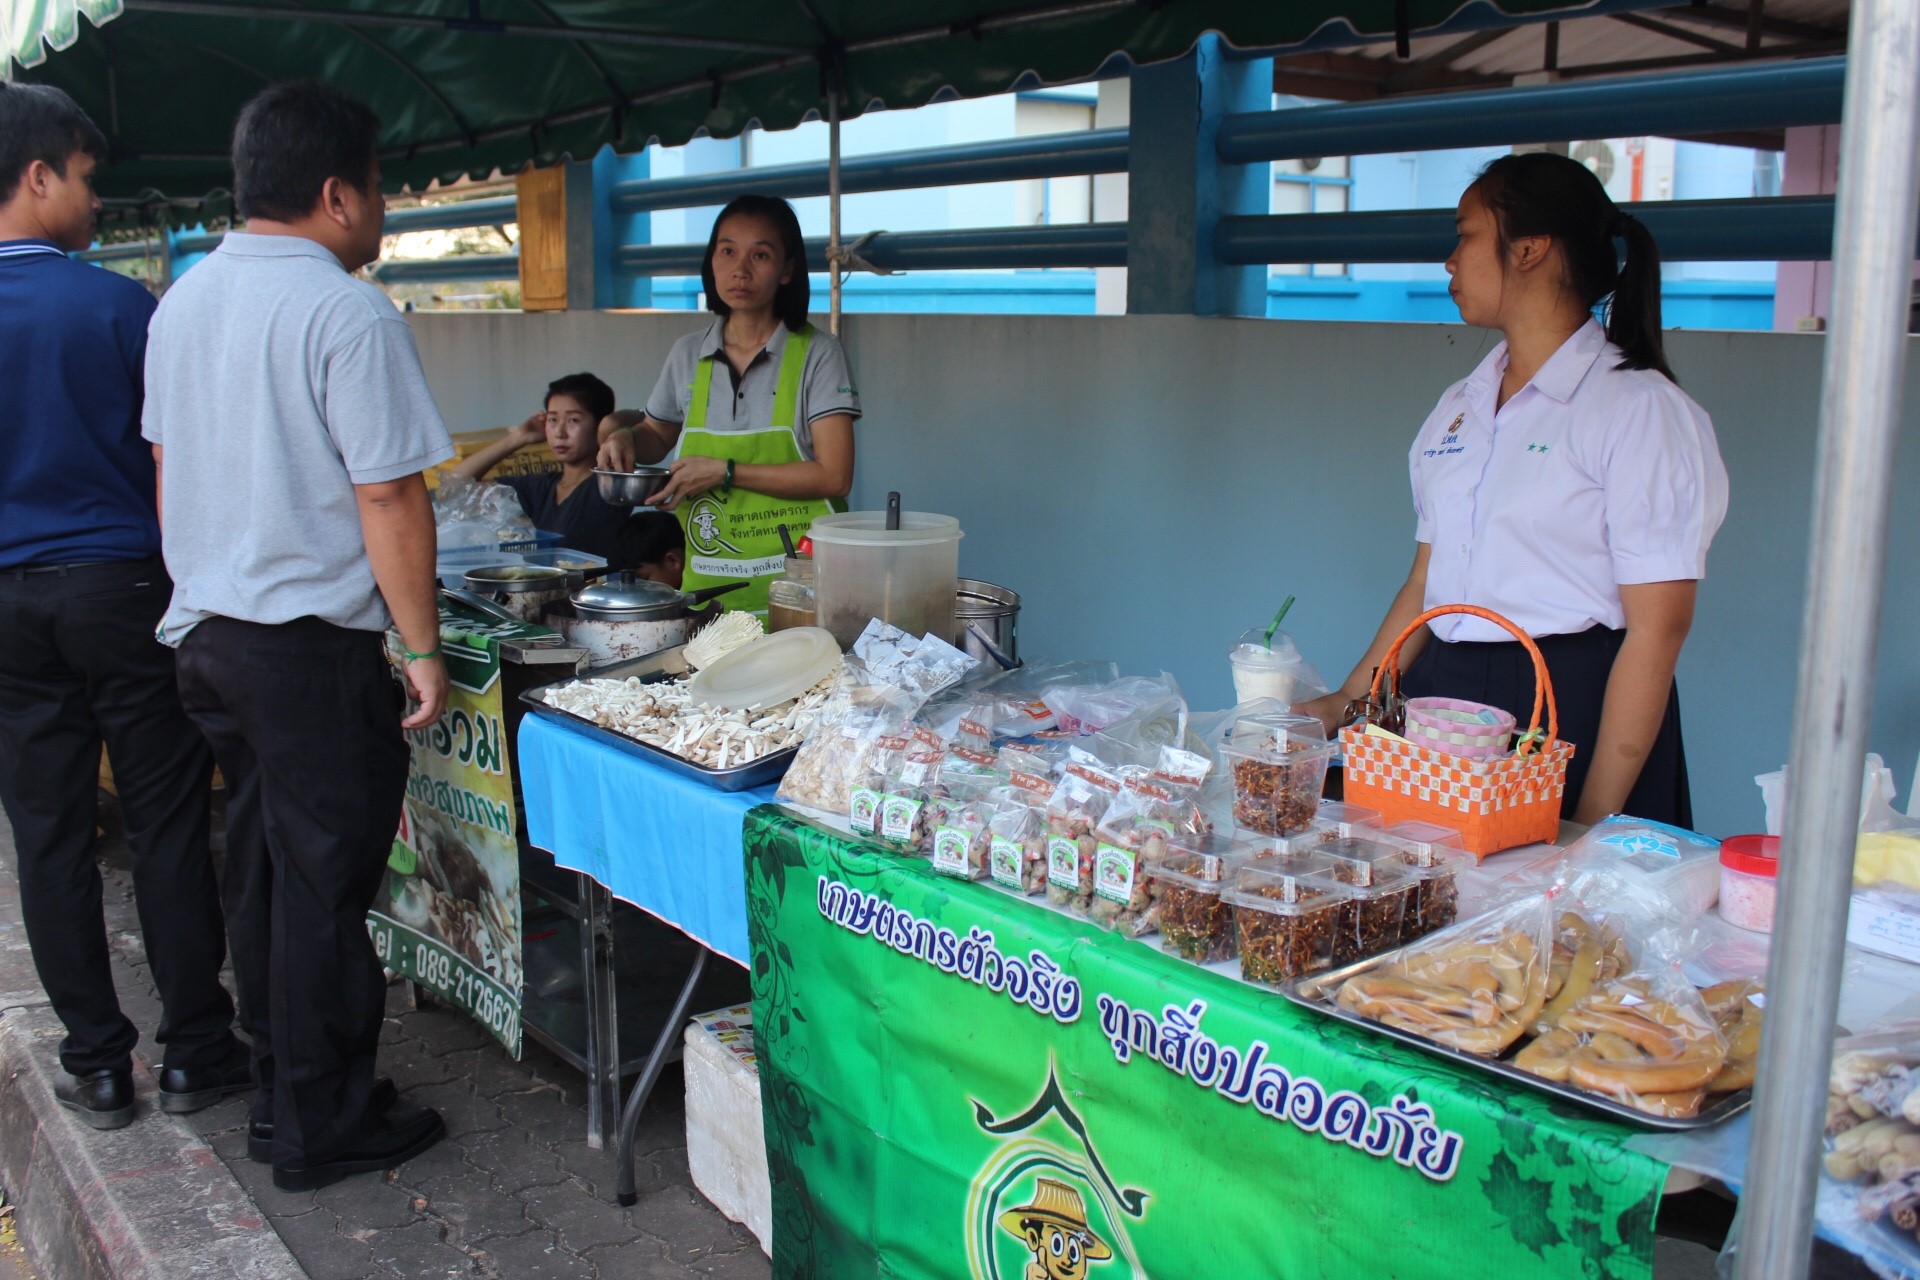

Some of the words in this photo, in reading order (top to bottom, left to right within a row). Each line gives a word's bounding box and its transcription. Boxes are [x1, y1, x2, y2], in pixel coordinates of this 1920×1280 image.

[729, 505, 810, 523] ตลาดเกษตรกร
[729, 522, 811, 539] จังหวัดหนงคาย
[752, 558, 785, 576] ทุกสิ่งป
[365, 919, 393, 961] Tel
[416, 943, 517, 1049] 089-2126620
[817, 875, 1081, 1023] เกษตรกรตัวจริง
[1097, 997, 1464, 1181] ทุกสิ่งปลอดภัย
